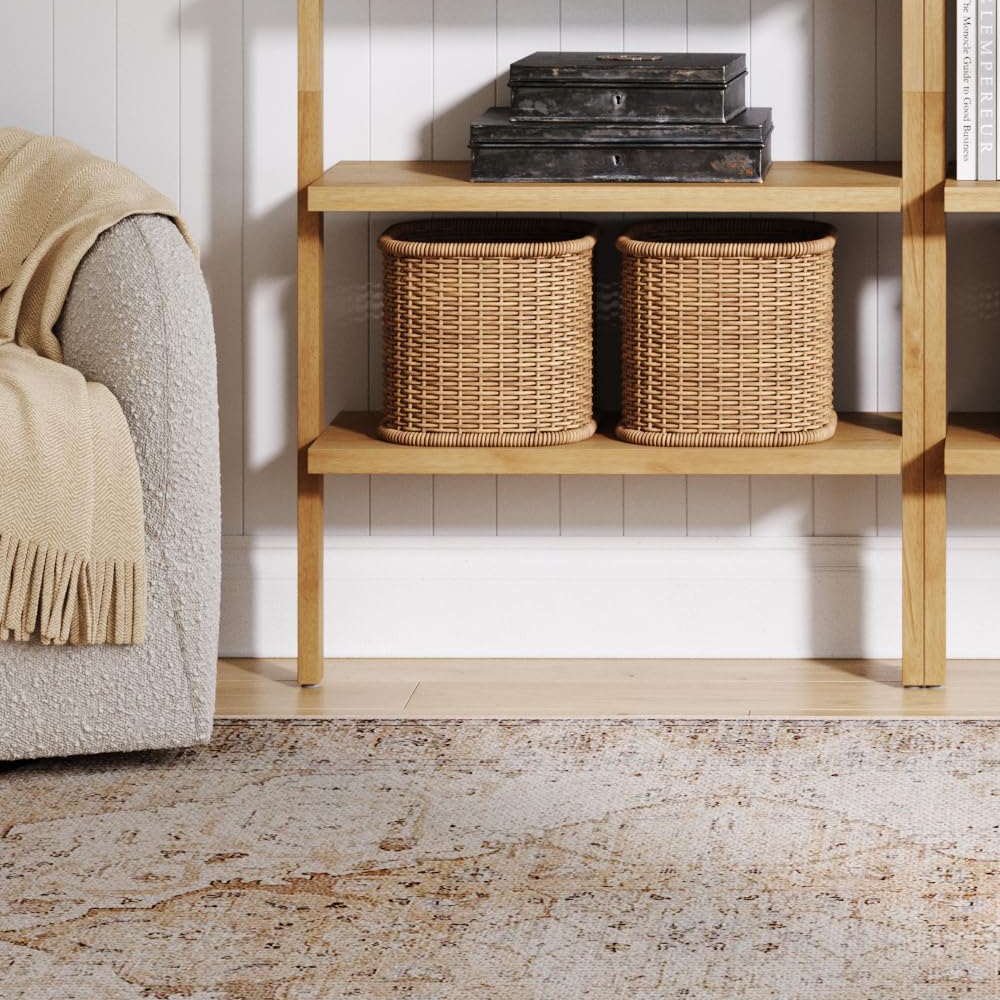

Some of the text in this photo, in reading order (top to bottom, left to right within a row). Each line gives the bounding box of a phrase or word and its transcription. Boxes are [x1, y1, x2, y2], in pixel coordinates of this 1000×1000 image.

[963, 16, 971, 55] Monocle
[963, 57, 971, 83] Guide
[980, 10, 993, 153] LEMPEREUR
[963, 86, 970, 95] to
[963, 97, 971, 122] Good
[963, 125, 971, 162] Business
